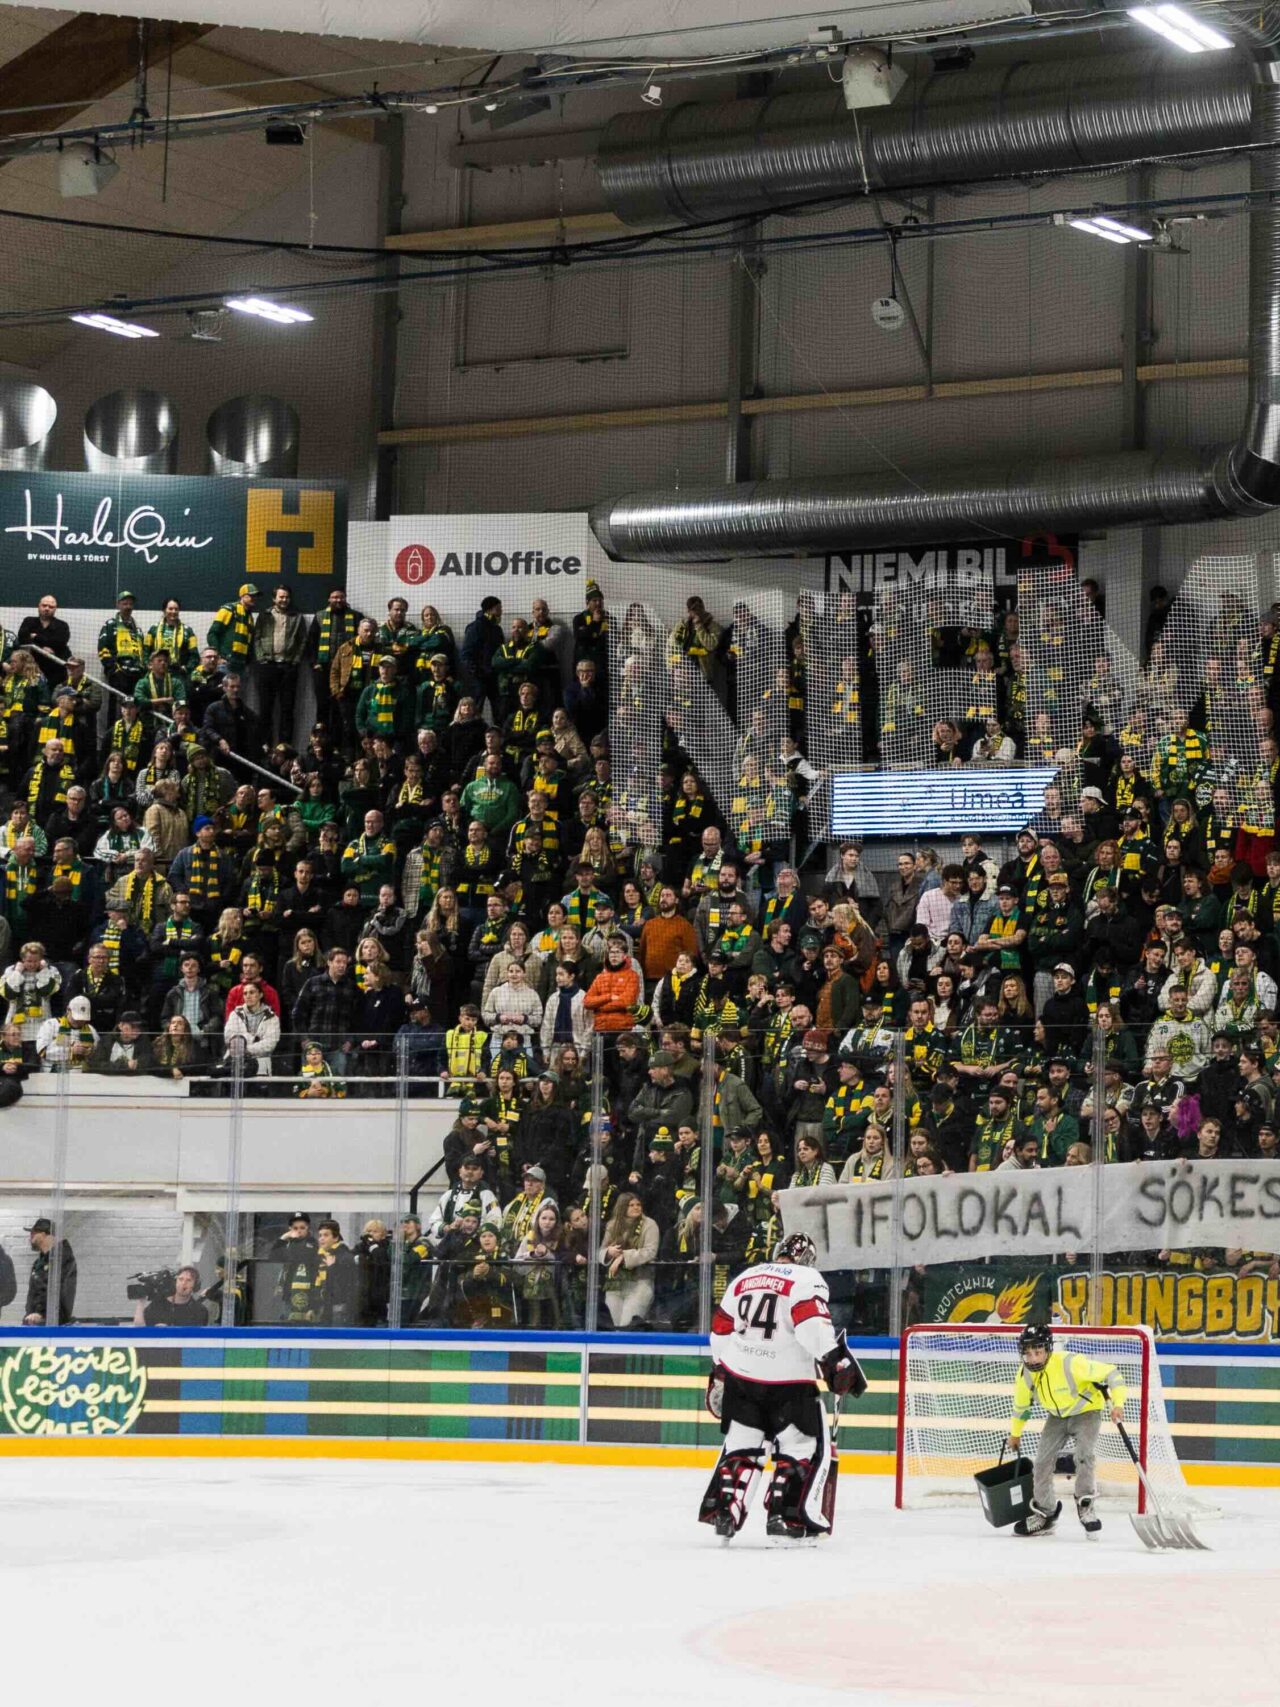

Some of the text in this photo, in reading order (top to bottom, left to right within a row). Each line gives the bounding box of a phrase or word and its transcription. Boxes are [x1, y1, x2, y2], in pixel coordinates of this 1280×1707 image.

[27, 552, 38, 561] BY
[39, 553, 73, 562] HUNGER
[83, 552, 110, 563] TÖRST
[440, 551, 582, 577] AllOffice
[829, 547, 1017, 594] NIEMI BIL
[804, 1185, 1082, 1252] TIFOLOKAL
[737, 1293, 779, 1340] 94
